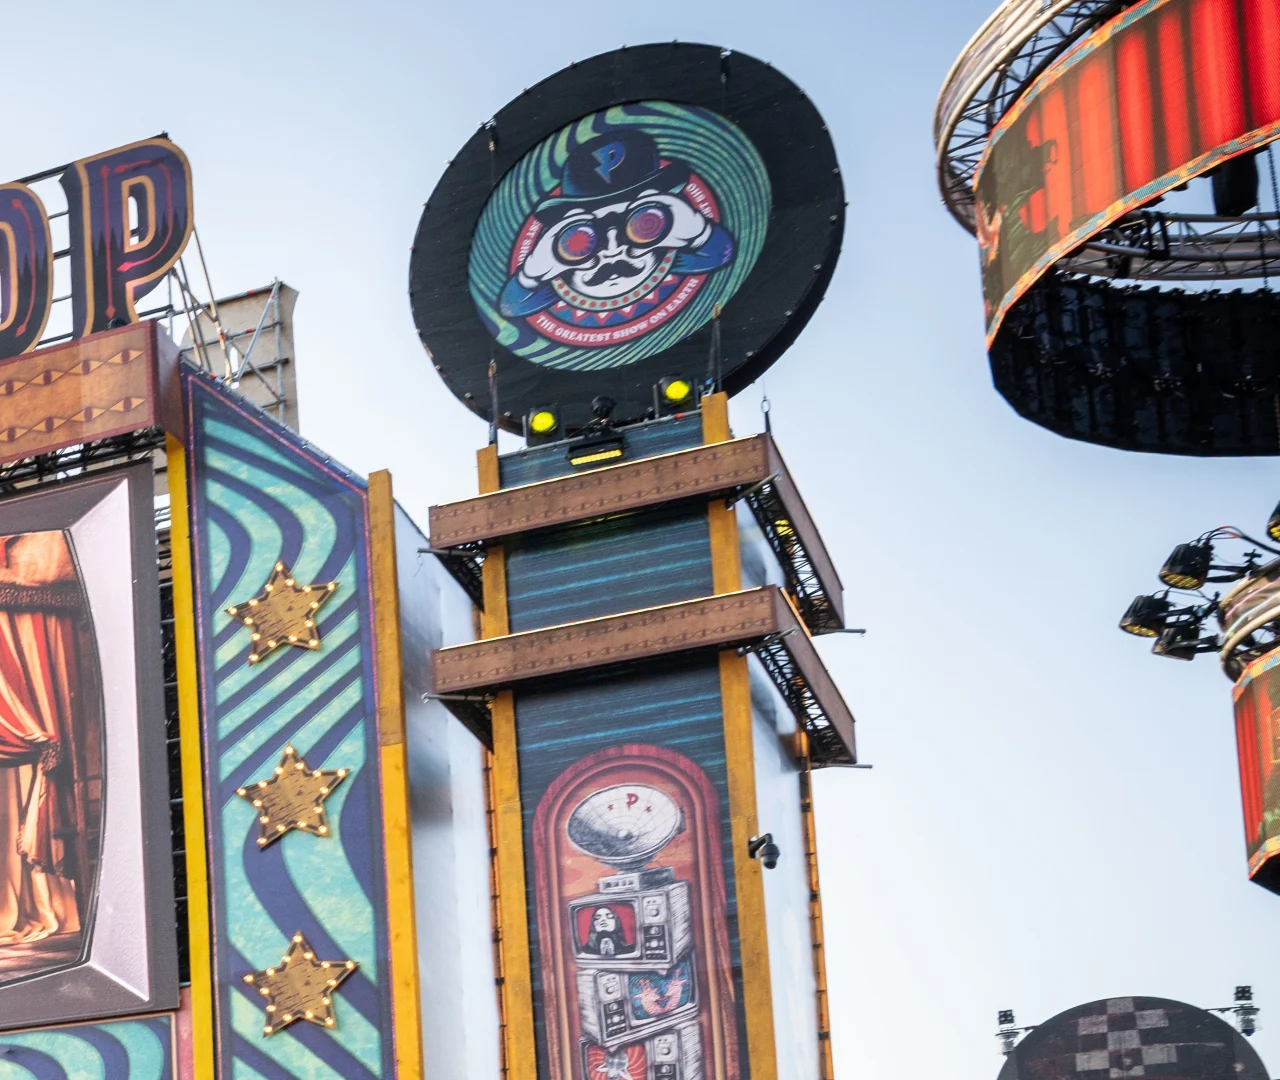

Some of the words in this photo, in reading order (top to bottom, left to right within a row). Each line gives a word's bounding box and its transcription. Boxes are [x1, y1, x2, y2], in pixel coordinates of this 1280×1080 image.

[536, 316, 554, 332] THE
[555, 327, 610, 343] GREATEST
[612, 321, 648, 340] SHOW
[650, 309, 667, 325] ON
[665, 278, 700, 315] EARTH
